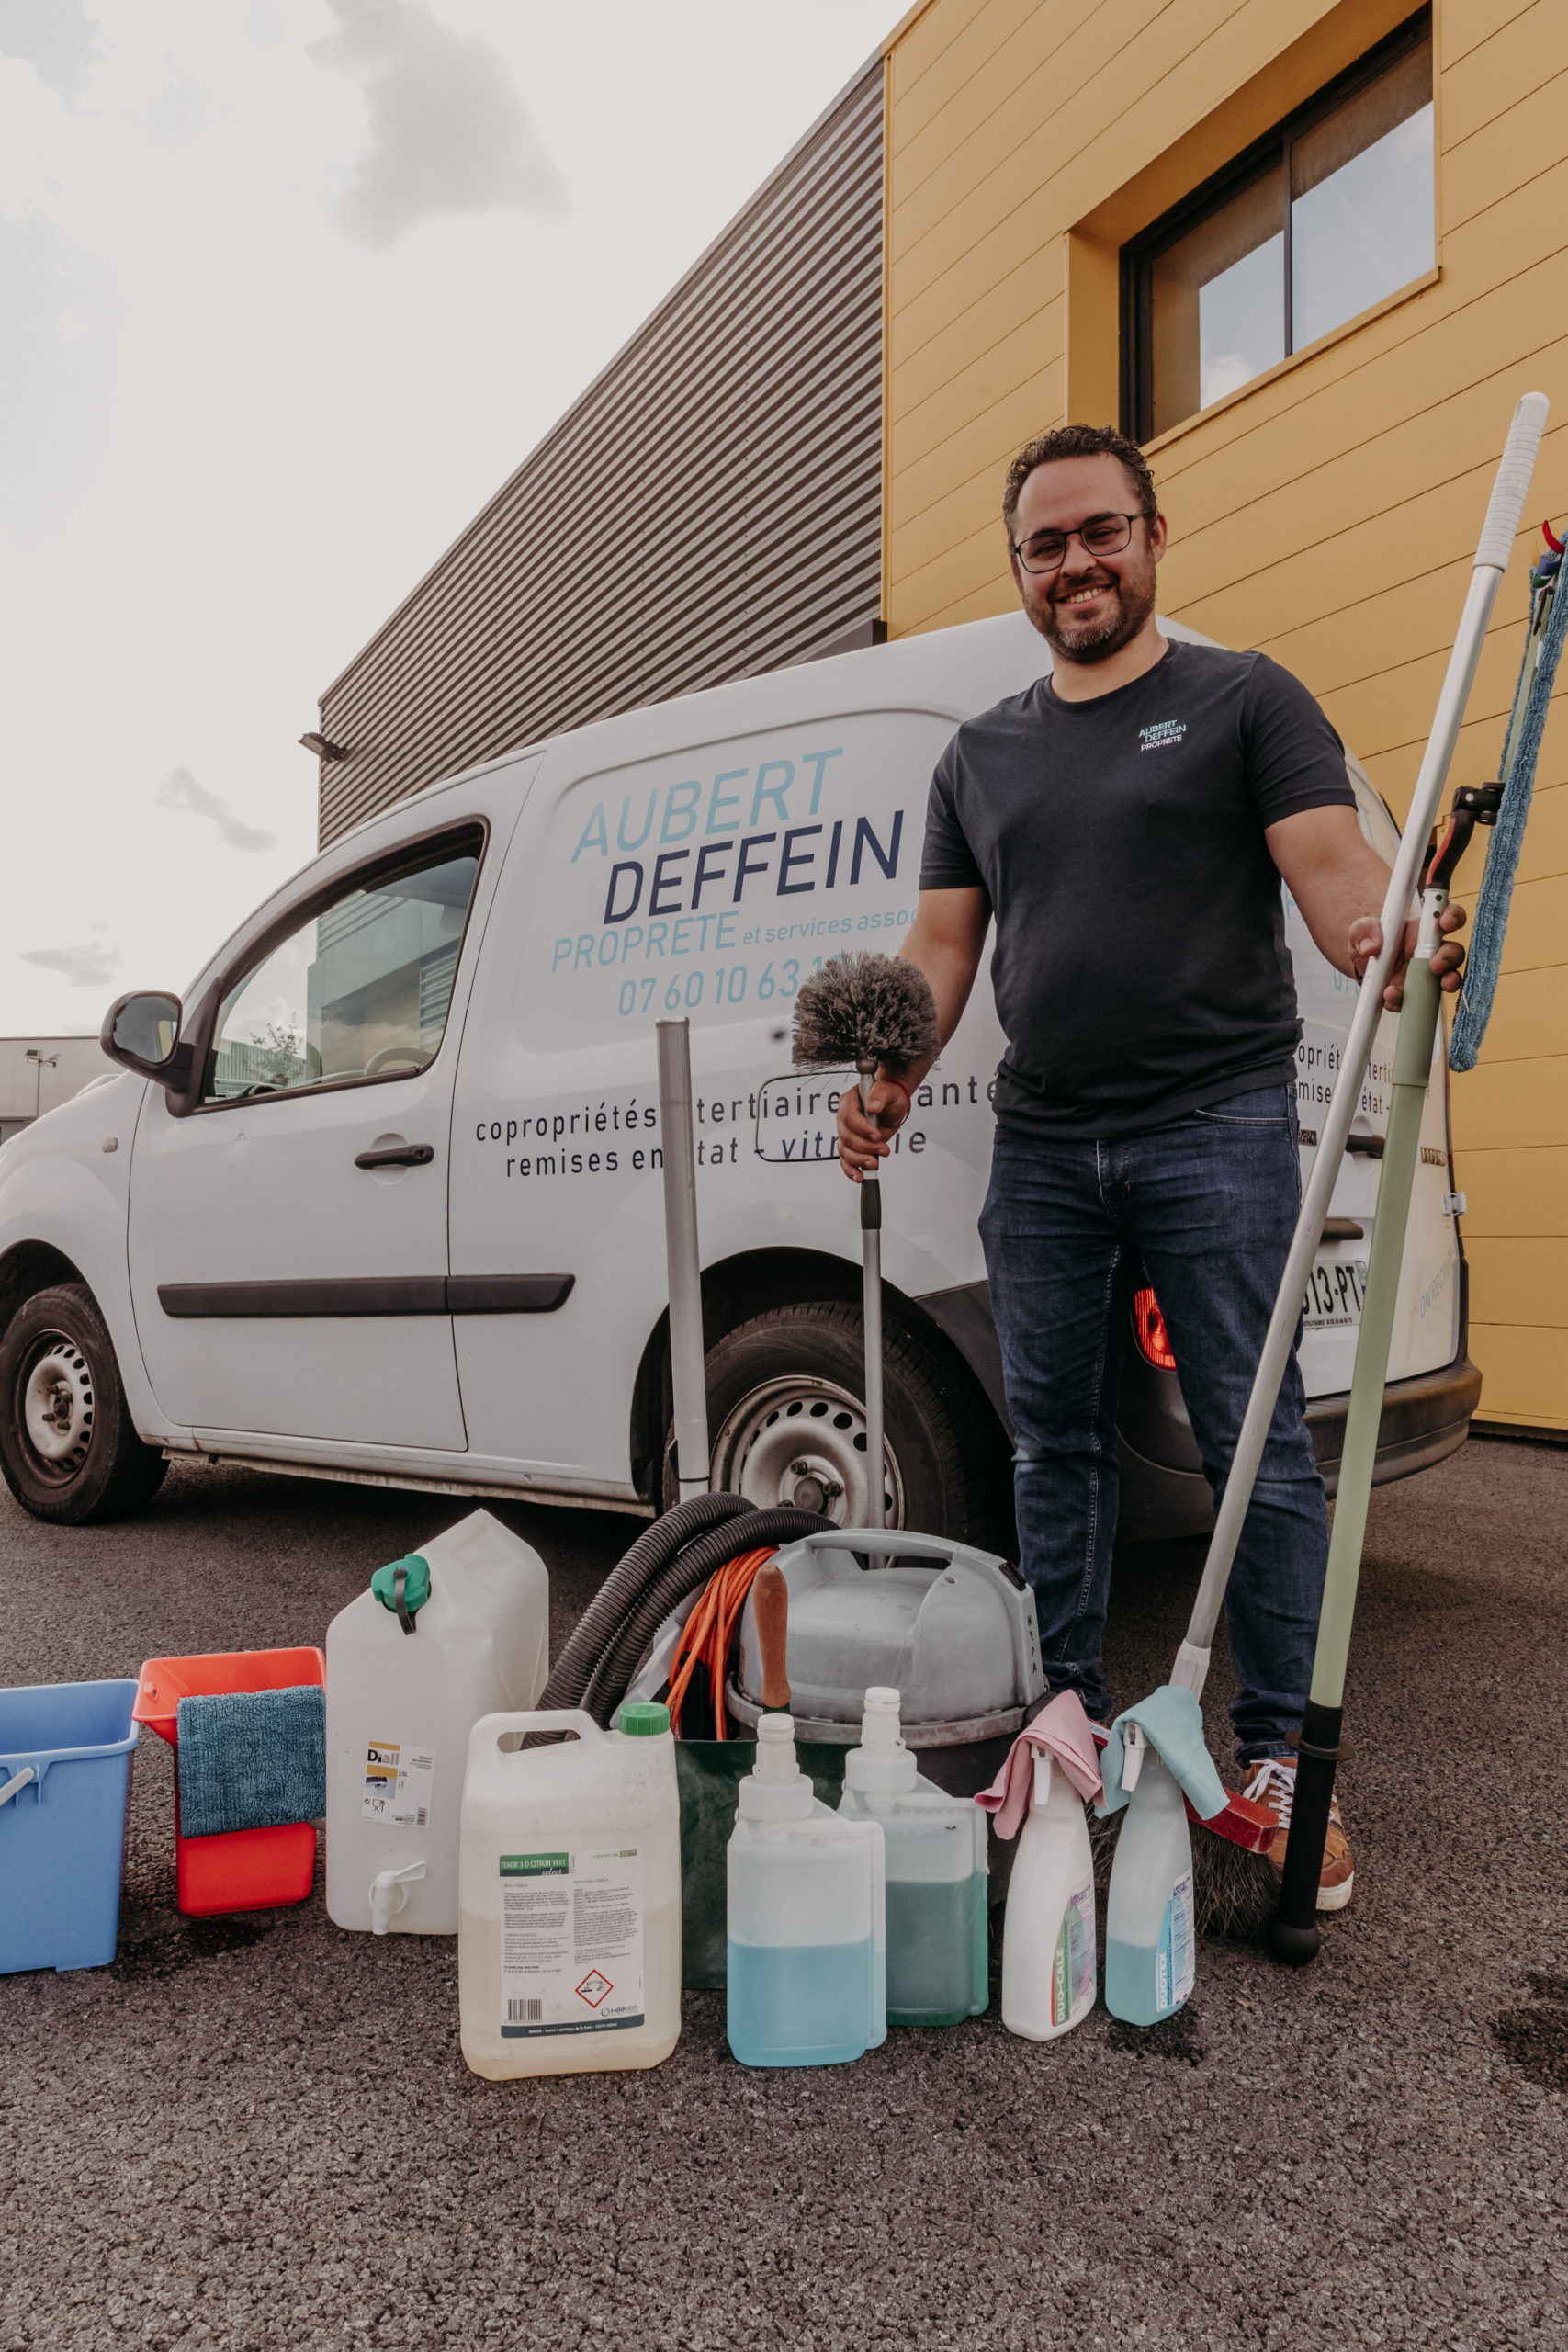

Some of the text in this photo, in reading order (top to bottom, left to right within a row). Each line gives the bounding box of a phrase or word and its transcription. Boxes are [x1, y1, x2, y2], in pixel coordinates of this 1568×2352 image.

[1139, 719, 1177, 738] AUBERT
[1141, 734, 1182, 752] PROPRETE
[1145, 724, 1186, 742] DEFFEIN
[570, 747, 844, 864] AUBERT
[604, 809, 904, 924] DEFFEIN
[552, 910, 739, 974] PROPRETE
[743, 926, 761, 945] et
[765, 917, 852, 943] services
[618, 977, 657, 1016] 07
[664, 971, 704, 1011] 60
[715, 966, 748, 1004] 10
[757, 958, 800, 1001] 63
[476, 1098, 657, 1147] copropriétés
[697, 1087, 840, 1123] tertiaire
[1361, 1086, 1382, 1114] état
[507, 1148, 618, 1177] remises
[632, 1148, 663, 1170] en
[697, 1137, 738, 1165] tat
[367, 1748, 400, 1766] Diall
[500, 1860, 519, 1869] TENOR
[530, 1860, 551, 1868] CITRON
[552, 1859, 567, 1867] VERT
[1056, 1947, 1066, 2022] DUO-CALE
[1159, 1952, 1168, 2009] DUOTEX
